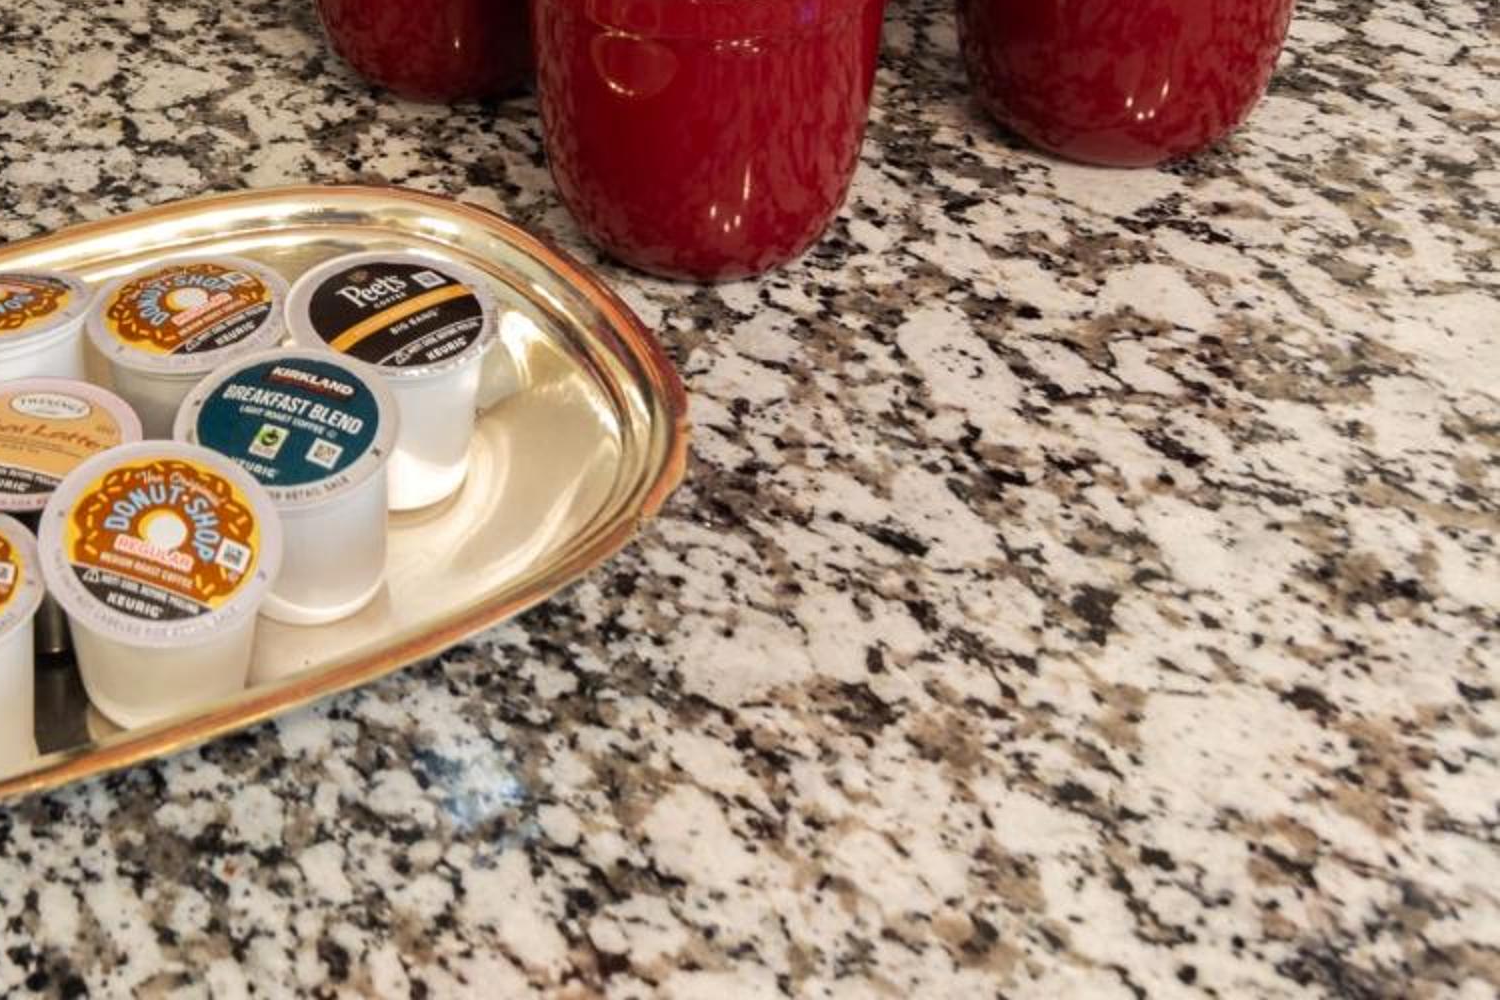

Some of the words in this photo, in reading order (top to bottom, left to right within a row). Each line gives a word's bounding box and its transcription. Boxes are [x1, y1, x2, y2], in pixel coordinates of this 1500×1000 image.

[138, 279, 170, 326] DONUT
[174, 276, 231, 291] SHOP
[271, 366, 355, 396] KIRKLAND
[222, 384, 312, 415] BREAKFAST
[308, 404, 364, 435] BLEND
[104, 482, 186, 531] DONUT
[184, 498, 221, 561] SHOP
[107, 592, 161, 617] KEURIG
